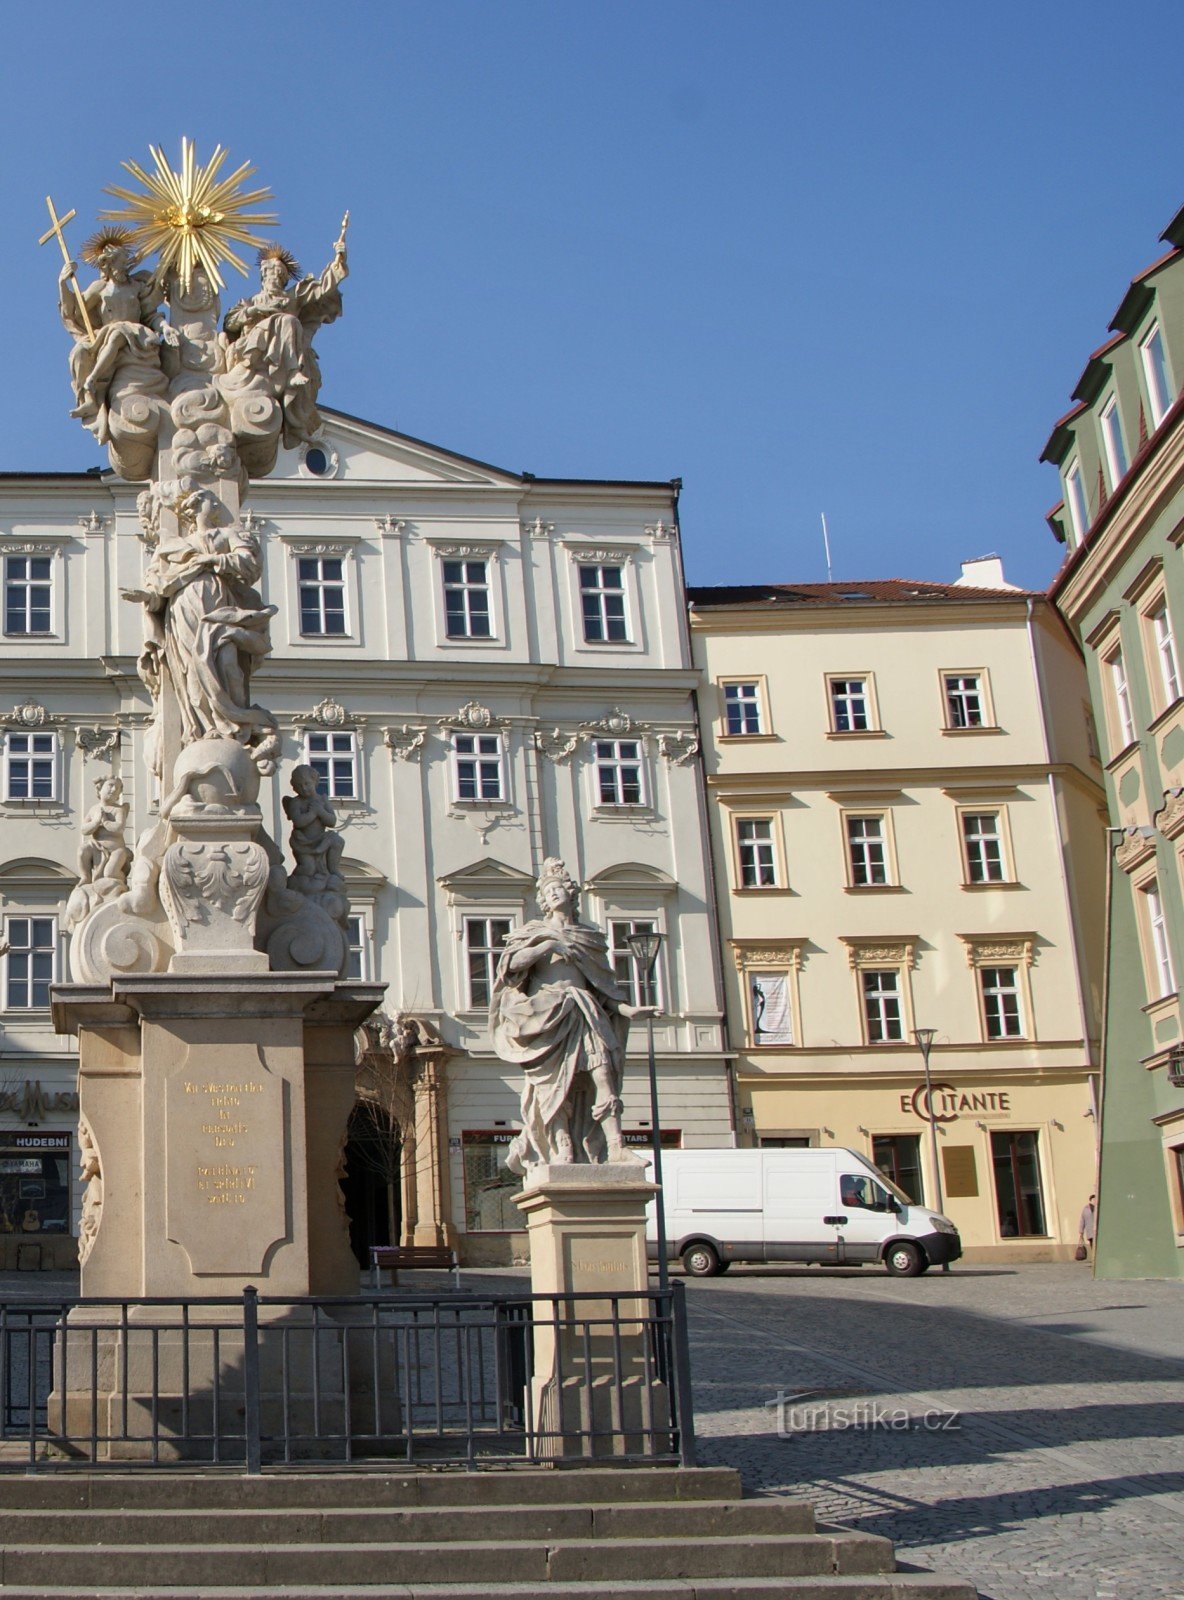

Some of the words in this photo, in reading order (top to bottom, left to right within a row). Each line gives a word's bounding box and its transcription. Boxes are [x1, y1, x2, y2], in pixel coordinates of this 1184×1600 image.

[16, 1136, 68, 1147] HUDEBNÍ
[493, 1134, 518, 1143] FUR
[10, 1160, 40, 1168] YAMAHA
